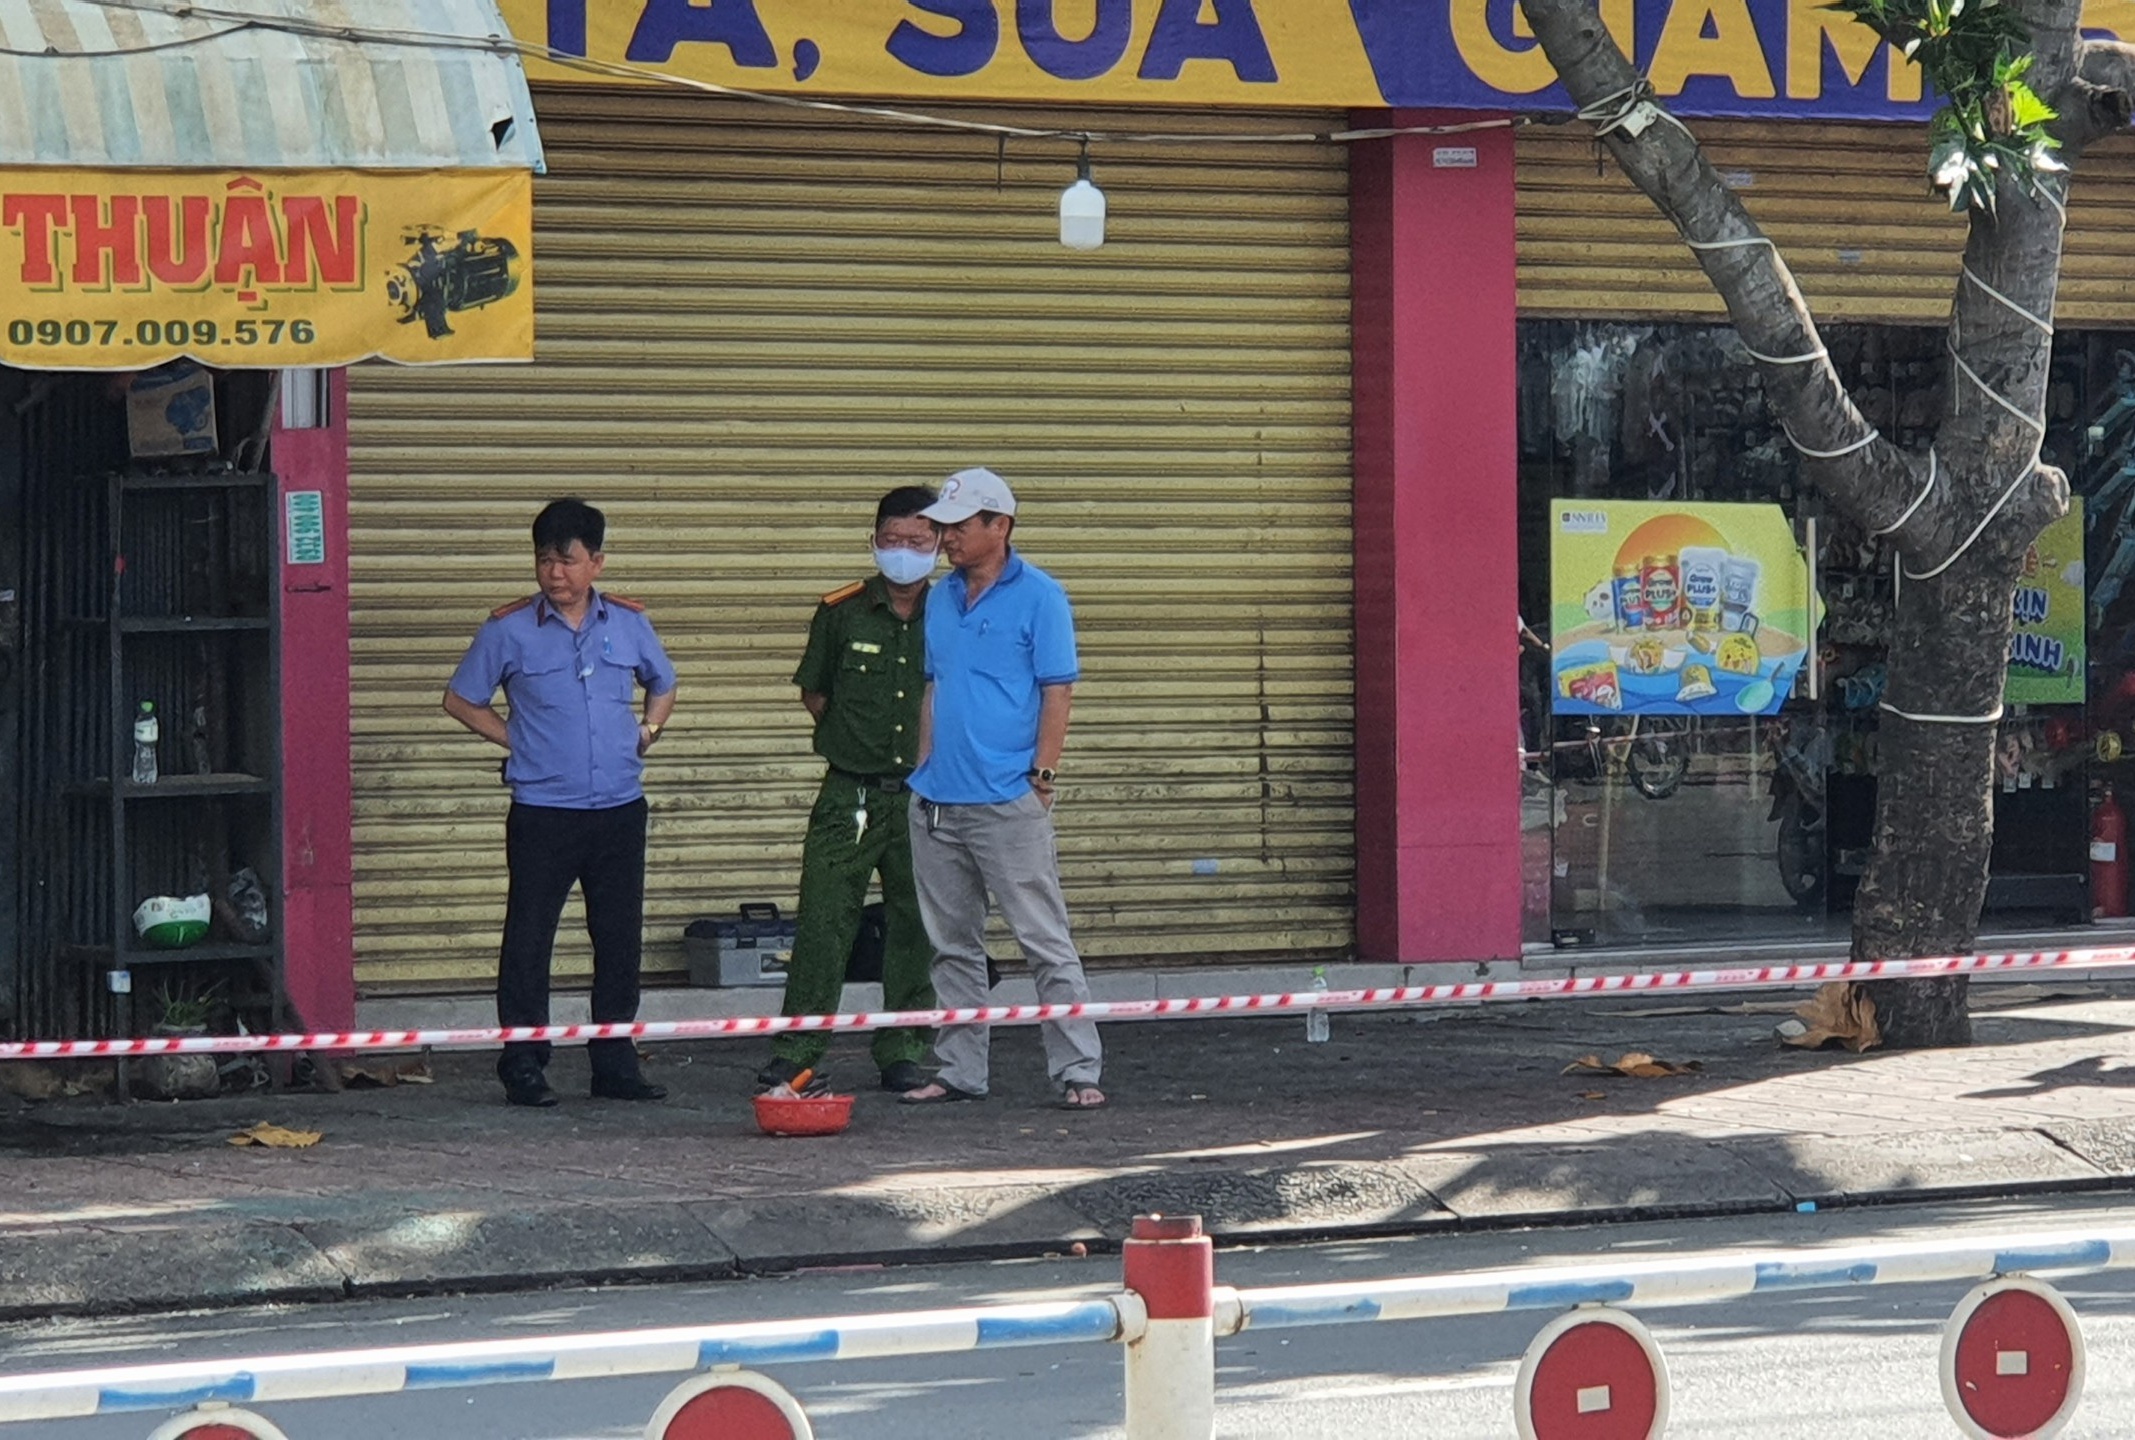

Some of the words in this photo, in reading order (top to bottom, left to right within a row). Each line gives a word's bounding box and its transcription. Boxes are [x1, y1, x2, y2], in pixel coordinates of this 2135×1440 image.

[3, 176, 357, 302] THUẬN
[8, 319, 315, 346] 0907.009.576
[2010, 632, 2063, 670] INH
